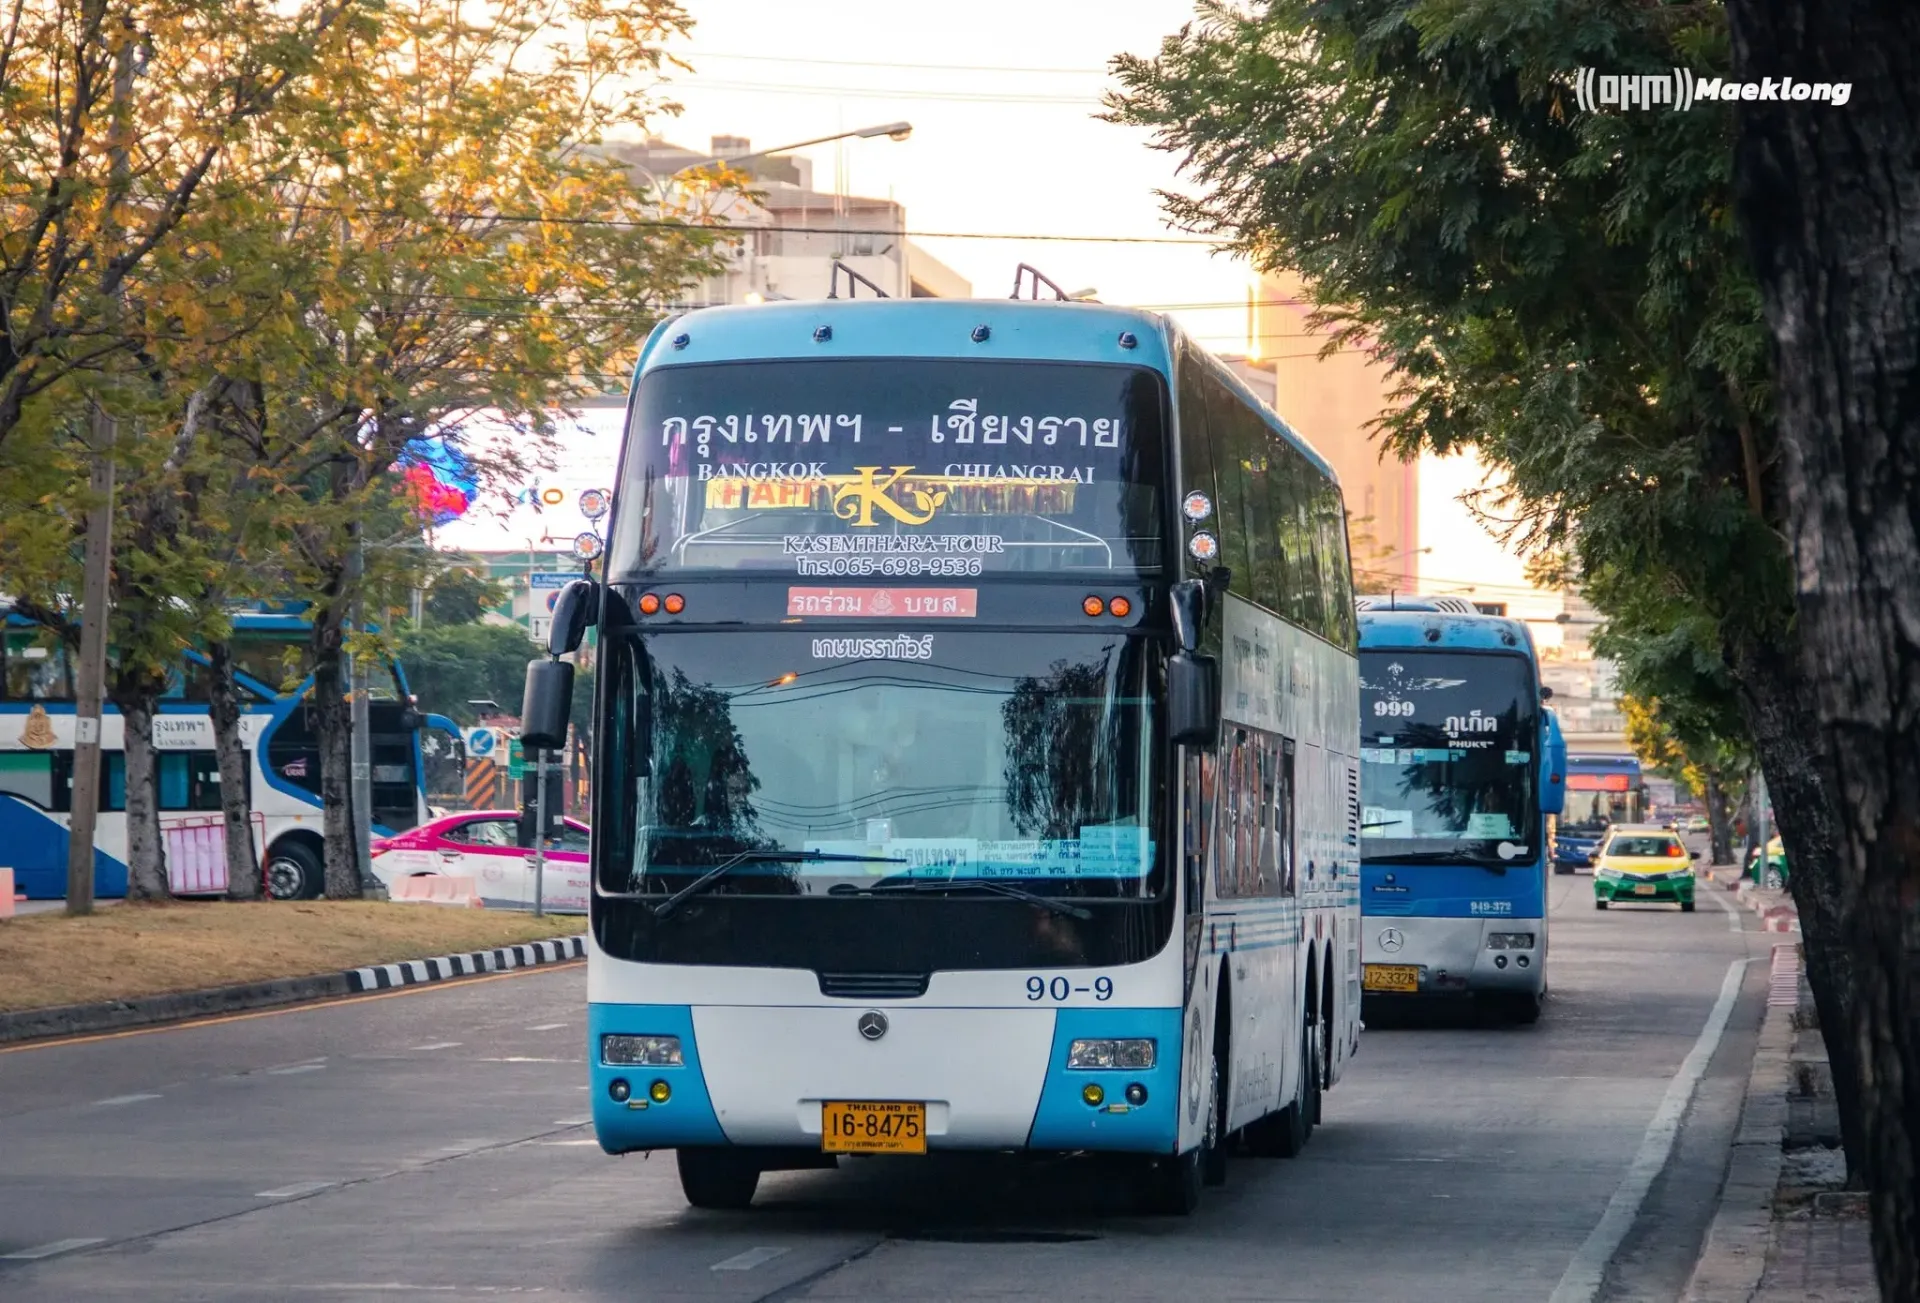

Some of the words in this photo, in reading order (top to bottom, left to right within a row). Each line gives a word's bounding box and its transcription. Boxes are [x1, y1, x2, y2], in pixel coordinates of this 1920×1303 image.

[662, 414, 862, 458] กรุงเทพฯ
[931, 398, 1120, 447] เชียงราย
[698, 462, 827, 481] BANGKOK
[944, 463, 1096, 484] CHIANGRAI
[784, 535, 937, 553] KASEMTHARA
[941, 535, 1004, 553] TOUR
[792, 589, 862, 612] รถร่วม
[904, 595, 967, 613] บขส.
[812, 633, 934, 660] เกษมธราทัวร์
[1374, 701, 1416, 717] 999
[154, 720, 206, 738] รุงเทพฯ
[1443, 709, 1498, 738] ภูเก็ต
[1026, 976, 1113, 1001] 90-9
[847, 1104, 901, 1112] THAILAND
[833, 1113, 918, 1138] 16-8475
